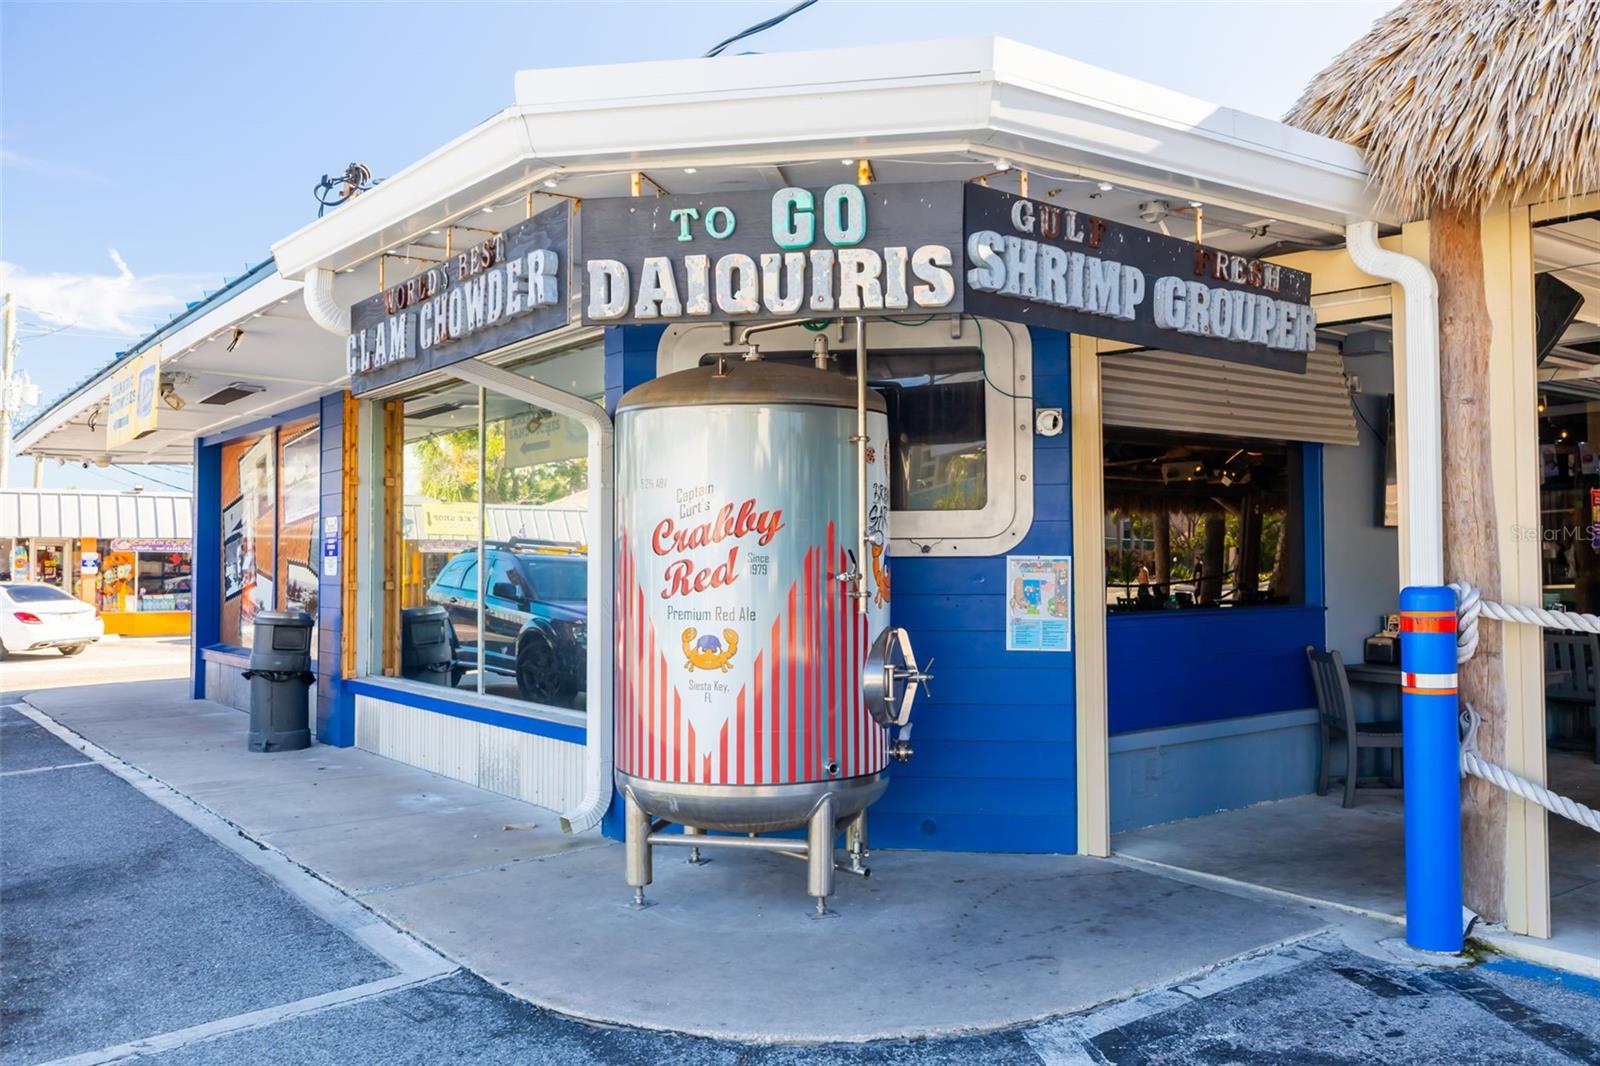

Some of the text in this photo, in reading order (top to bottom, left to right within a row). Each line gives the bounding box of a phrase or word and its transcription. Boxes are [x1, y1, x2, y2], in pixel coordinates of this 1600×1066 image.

[669, 183, 868, 249] TO GO
[458, 233, 506, 280] BEST
[1011, 199, 1281, 293] GULF FRESH
[587, 245, 955, 320] DAIQUIRIS
[968, 230, 1316, 352] SHRIMP GROUPER
[346, 249, 558, 375] CLAM CHOWDER
[676, 483, 715, 504] Captain
[679, 498, 711, 519] Curt's
[652, 497, 786, 556] Crabby
[660, 547, 739, 600] Red
[746, 551, 770, 564] Since
[749, 563, 769, 576] 1979
[667, 605, 757, 622] Premium Red Ale
[688, 679, 712, 692] Siesta
[704, 692, 713, 704] FL
